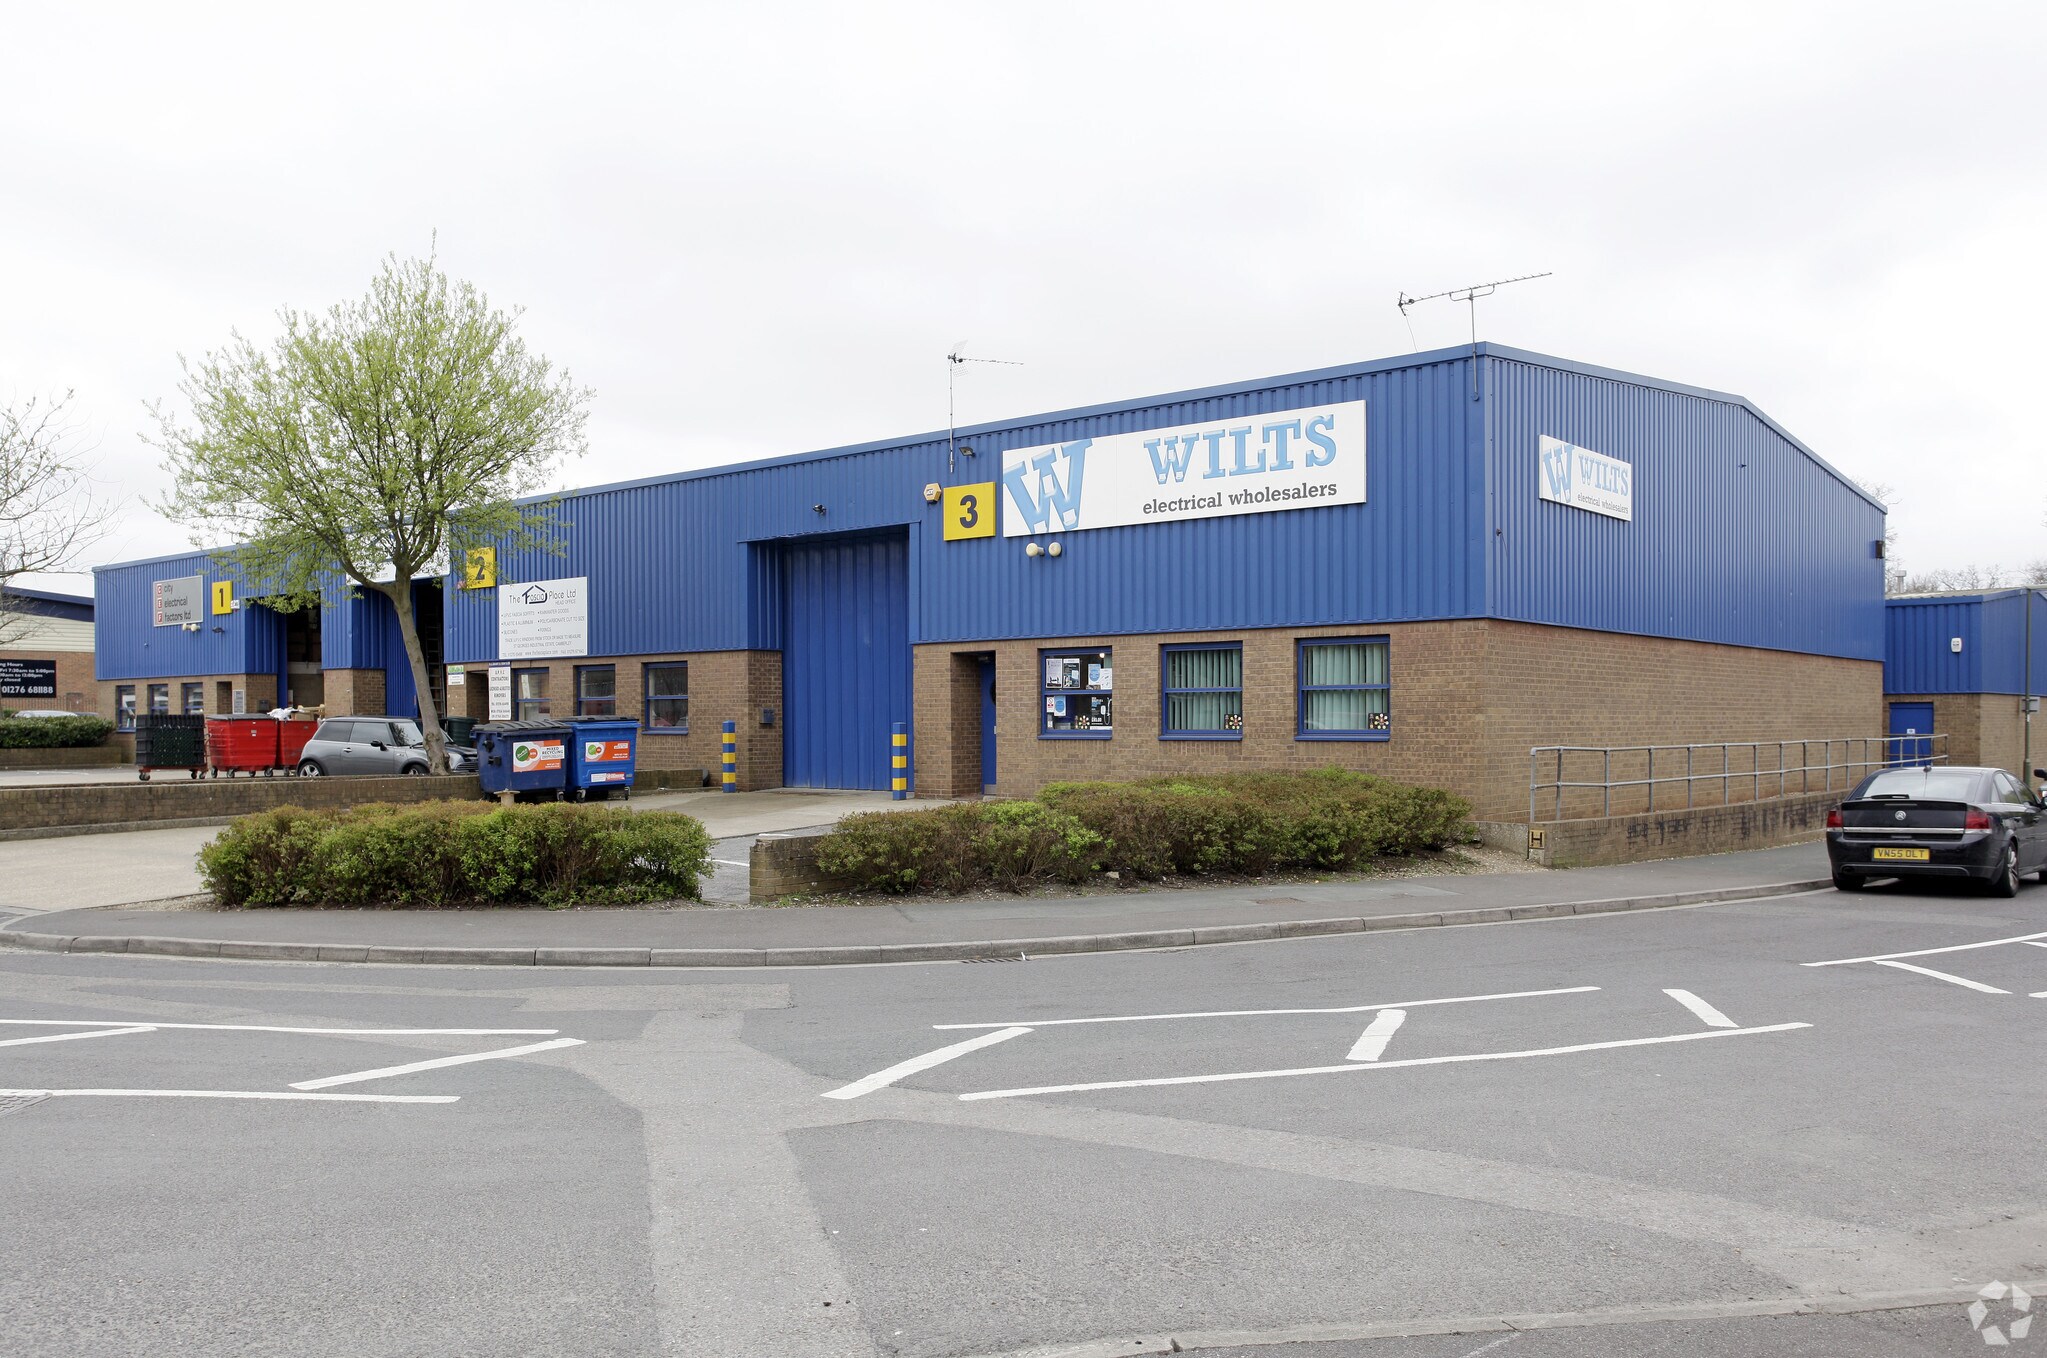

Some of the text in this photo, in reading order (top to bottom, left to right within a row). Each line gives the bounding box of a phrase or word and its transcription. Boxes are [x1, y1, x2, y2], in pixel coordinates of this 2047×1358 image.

[1144, 414, 1337, 485] WILTS
[1578, 454, 1629, 497] WILTS
[1003, 438, 1093, 535] W
[1143, 482, 1337, 515] electrical wholesalers
[1577, 493, 1629, 514] electrical wholesalers
[960, 494, 978, 529] 3
[474, 556, 486, 581] 2
[164, 584, 173, 594] city
[219, 588, 224, 607] 1
[509, 595, 521, 604] The
[549, 590, 565, 600] Place
[566, 589, 577, 599] Ltd
[164, 596, 188, 608] electrical
[164, 612, 183, 622] factors
[2, 686, 53, 694] 01276 681188
[1531, 831, 1543, 847] H
[1905, 850, 1925, 858] OLT
